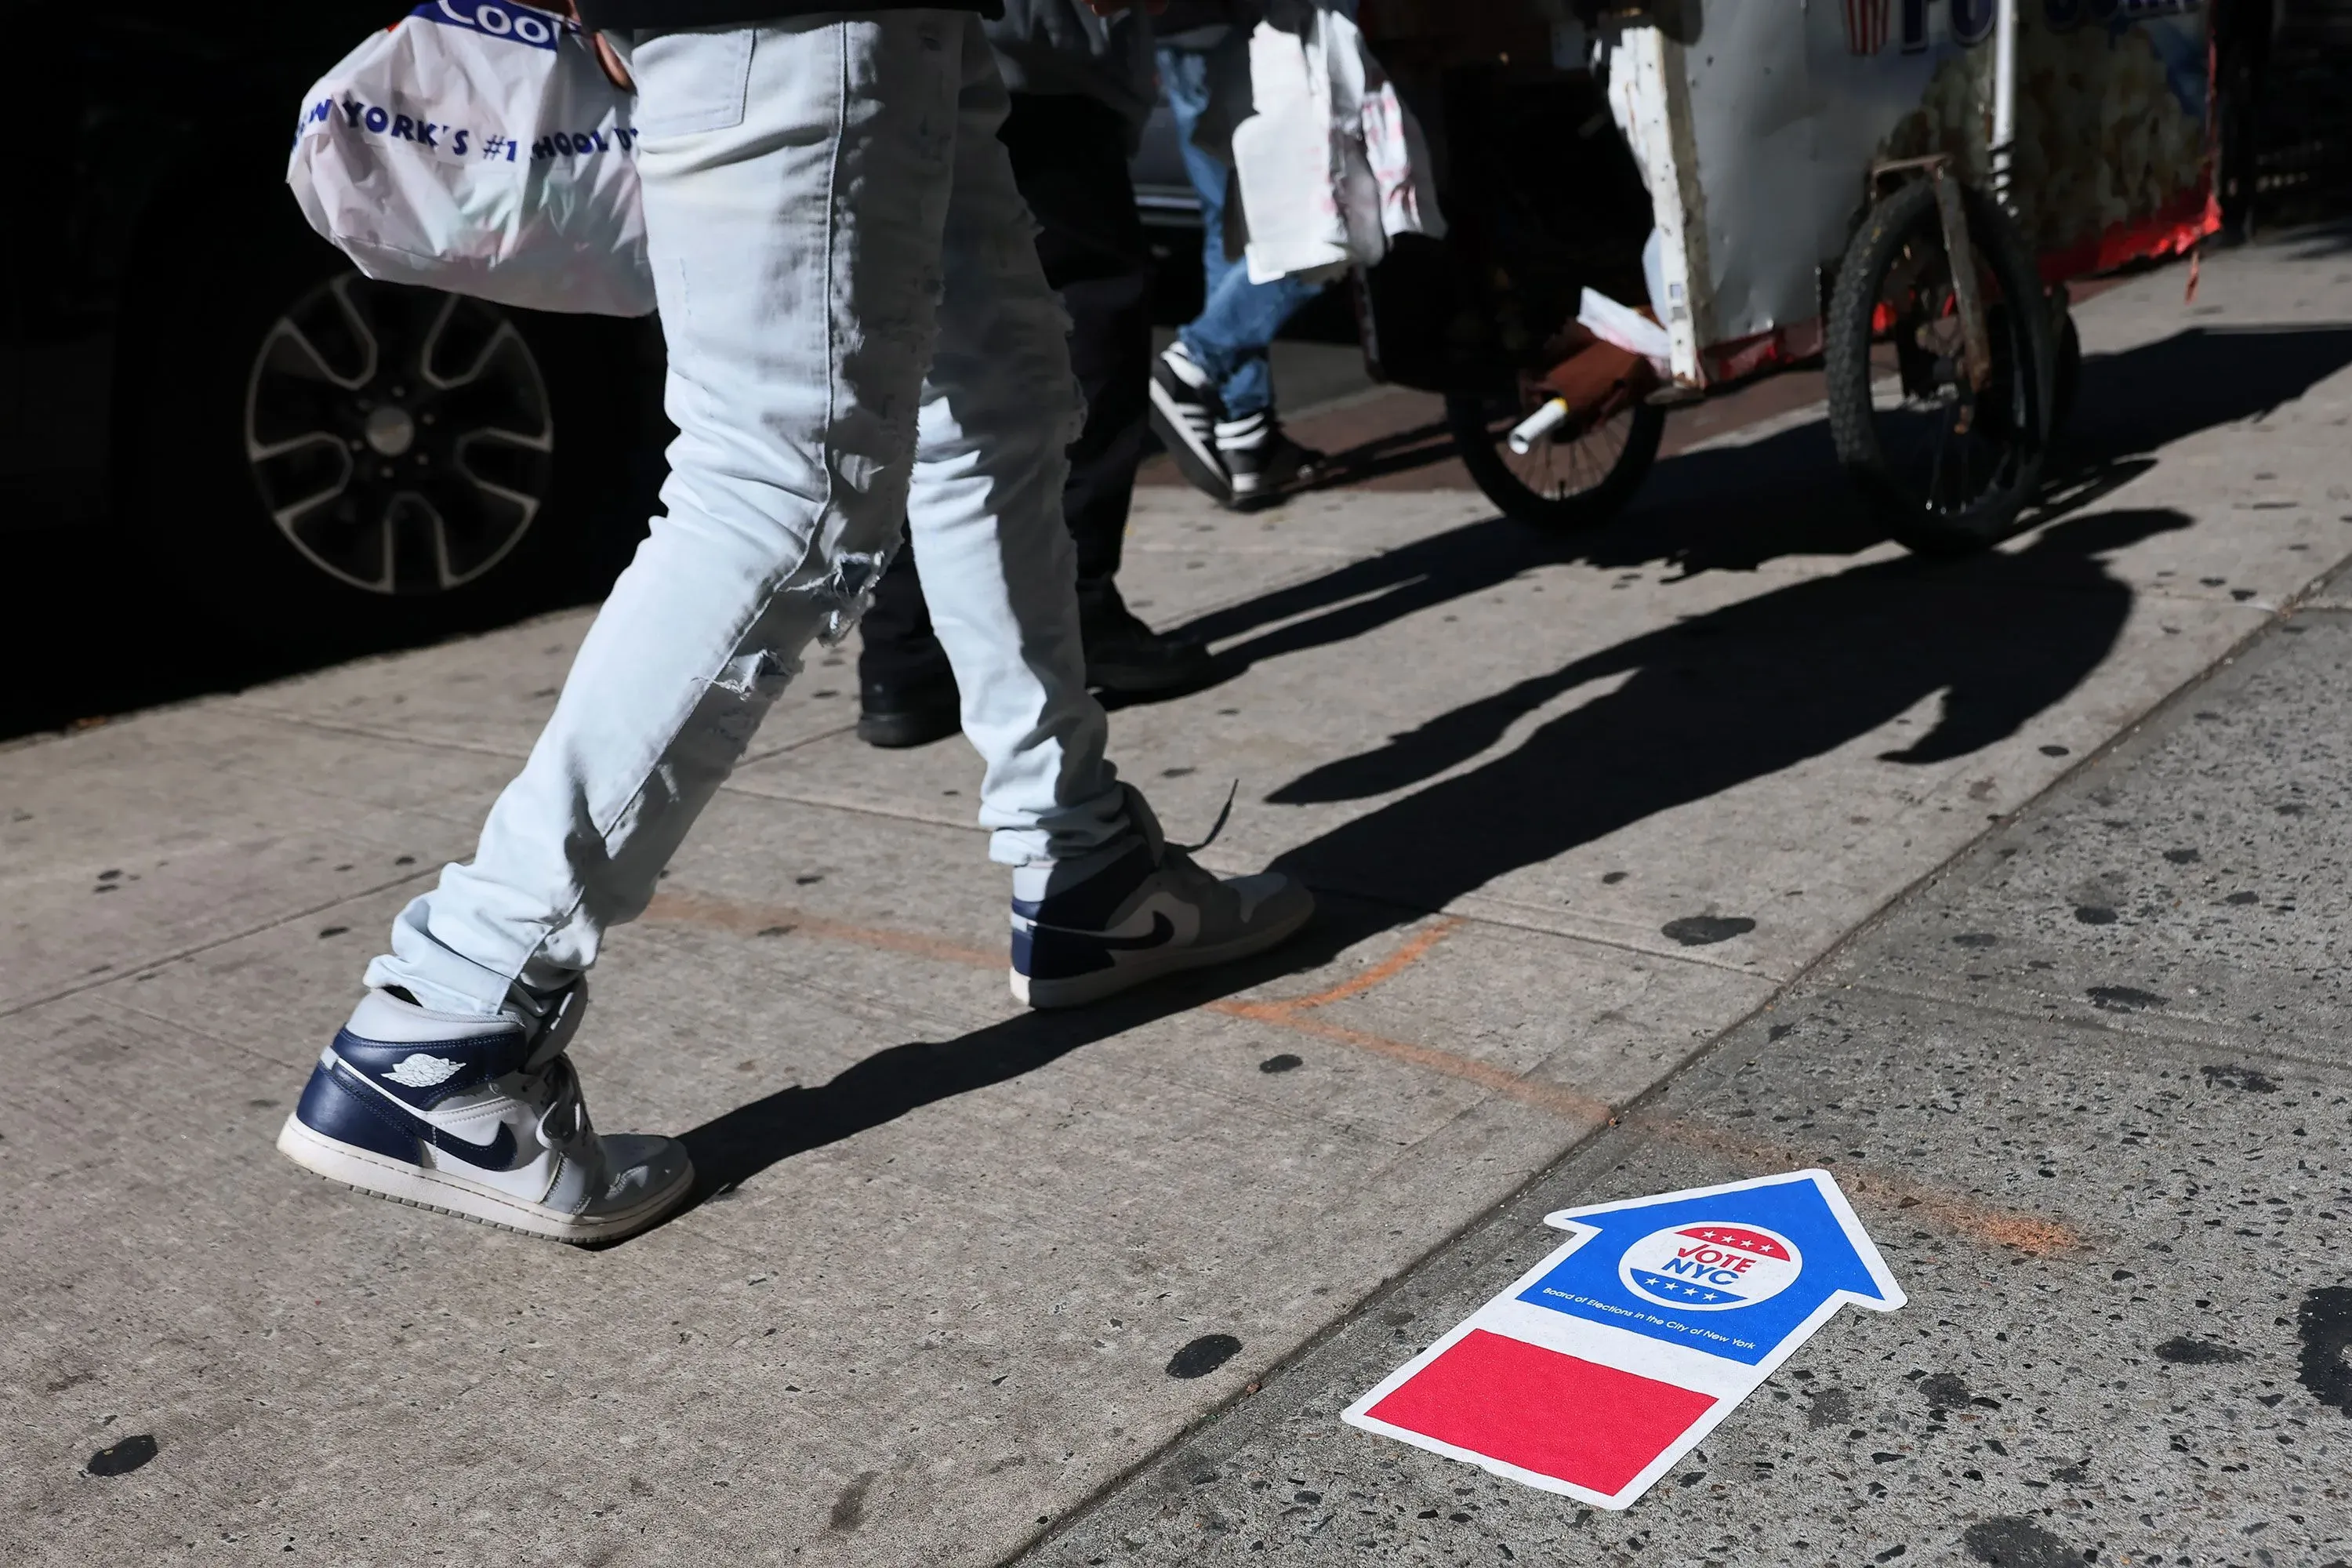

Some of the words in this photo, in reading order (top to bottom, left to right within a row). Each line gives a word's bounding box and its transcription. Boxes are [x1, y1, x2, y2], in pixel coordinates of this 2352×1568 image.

[342, 100, 469, 155] YORK'S
[483, 134, 517, 162] #1
[531, 131, 608, 160] HOOL
[1661, 1258, 1739, 1285] NYC
[1678, 1243, 1757, 1273] VOTE
[1543, 1287, 1575, 1300] Board
[1586, 1299, 1634, 1317] Elections
[1646, 1315, 1664, 1325] the
[1666, 1321, 1690, 1332] City
[1703, 1330, 1730, 1342] New
[1731, 1338, 1756, 1350] York
